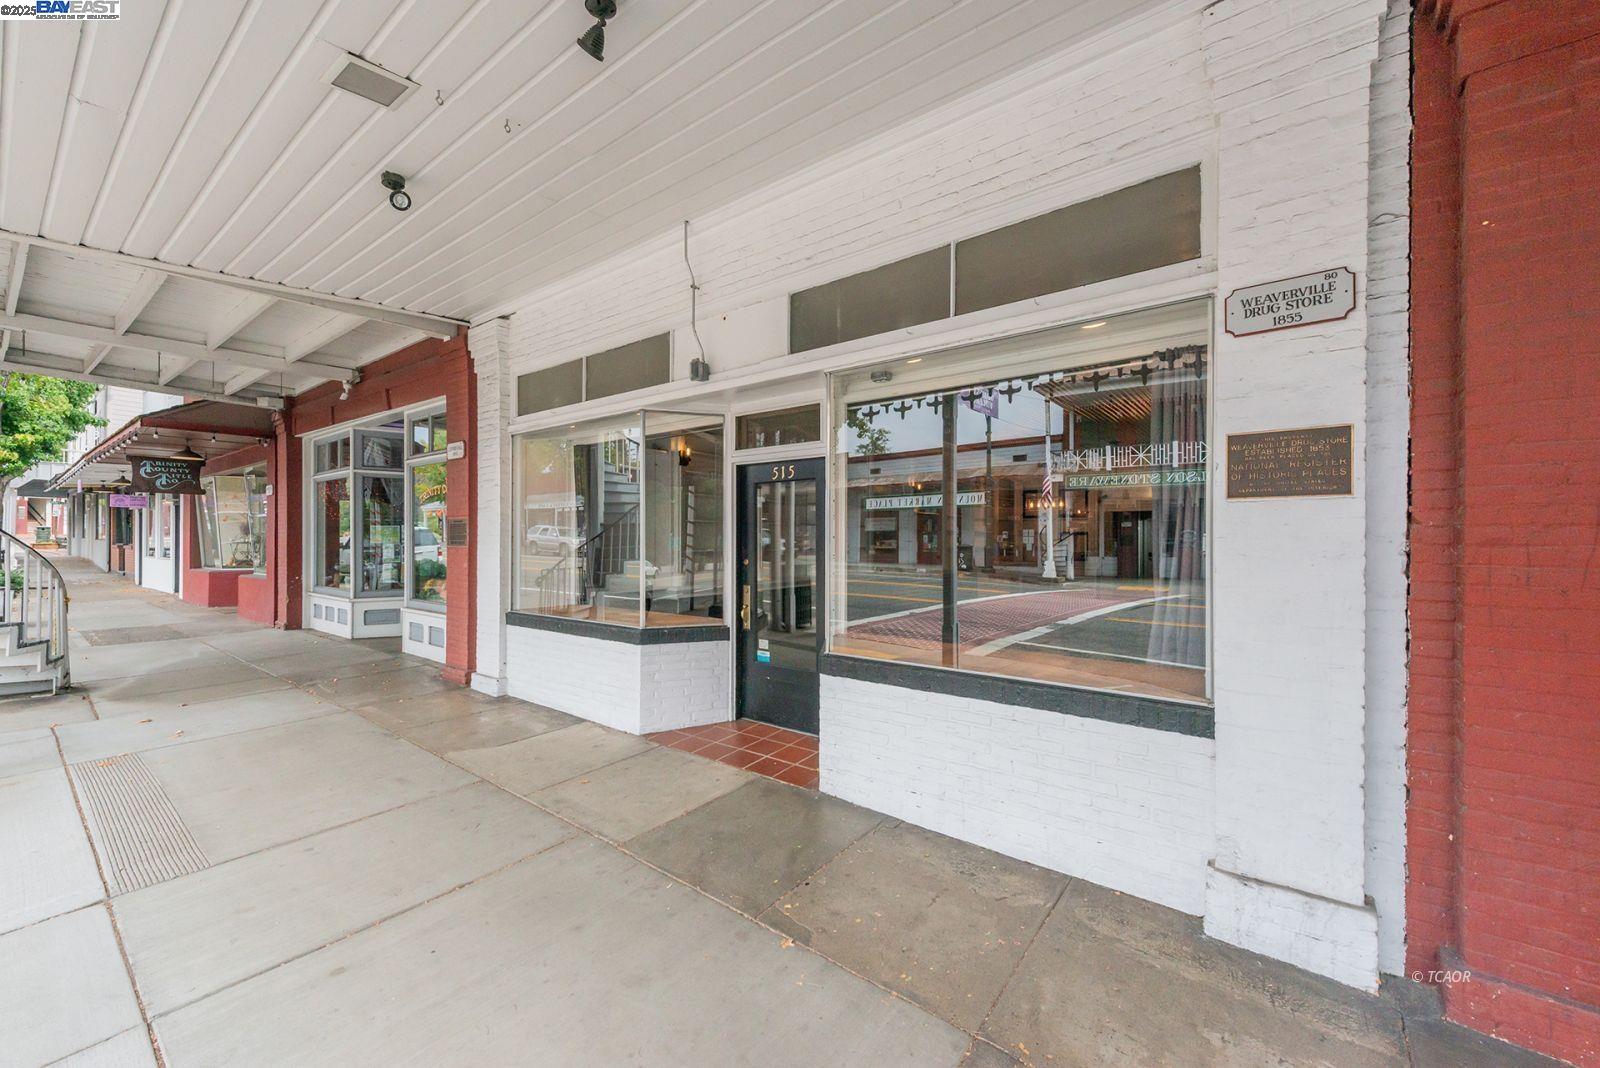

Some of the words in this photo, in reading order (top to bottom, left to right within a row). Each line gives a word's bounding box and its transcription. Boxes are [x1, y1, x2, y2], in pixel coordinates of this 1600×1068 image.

[1324, 271, 1338, 280] 80
[1240, 281, 1337, 309] WEAVERVILLE
[1244, 303, 1280, 319] DRUG
[1285, 292, 1333, 311] STORE
[1273, 312, 1303, 326] 1855
[772, 465, 795, 480] 515
